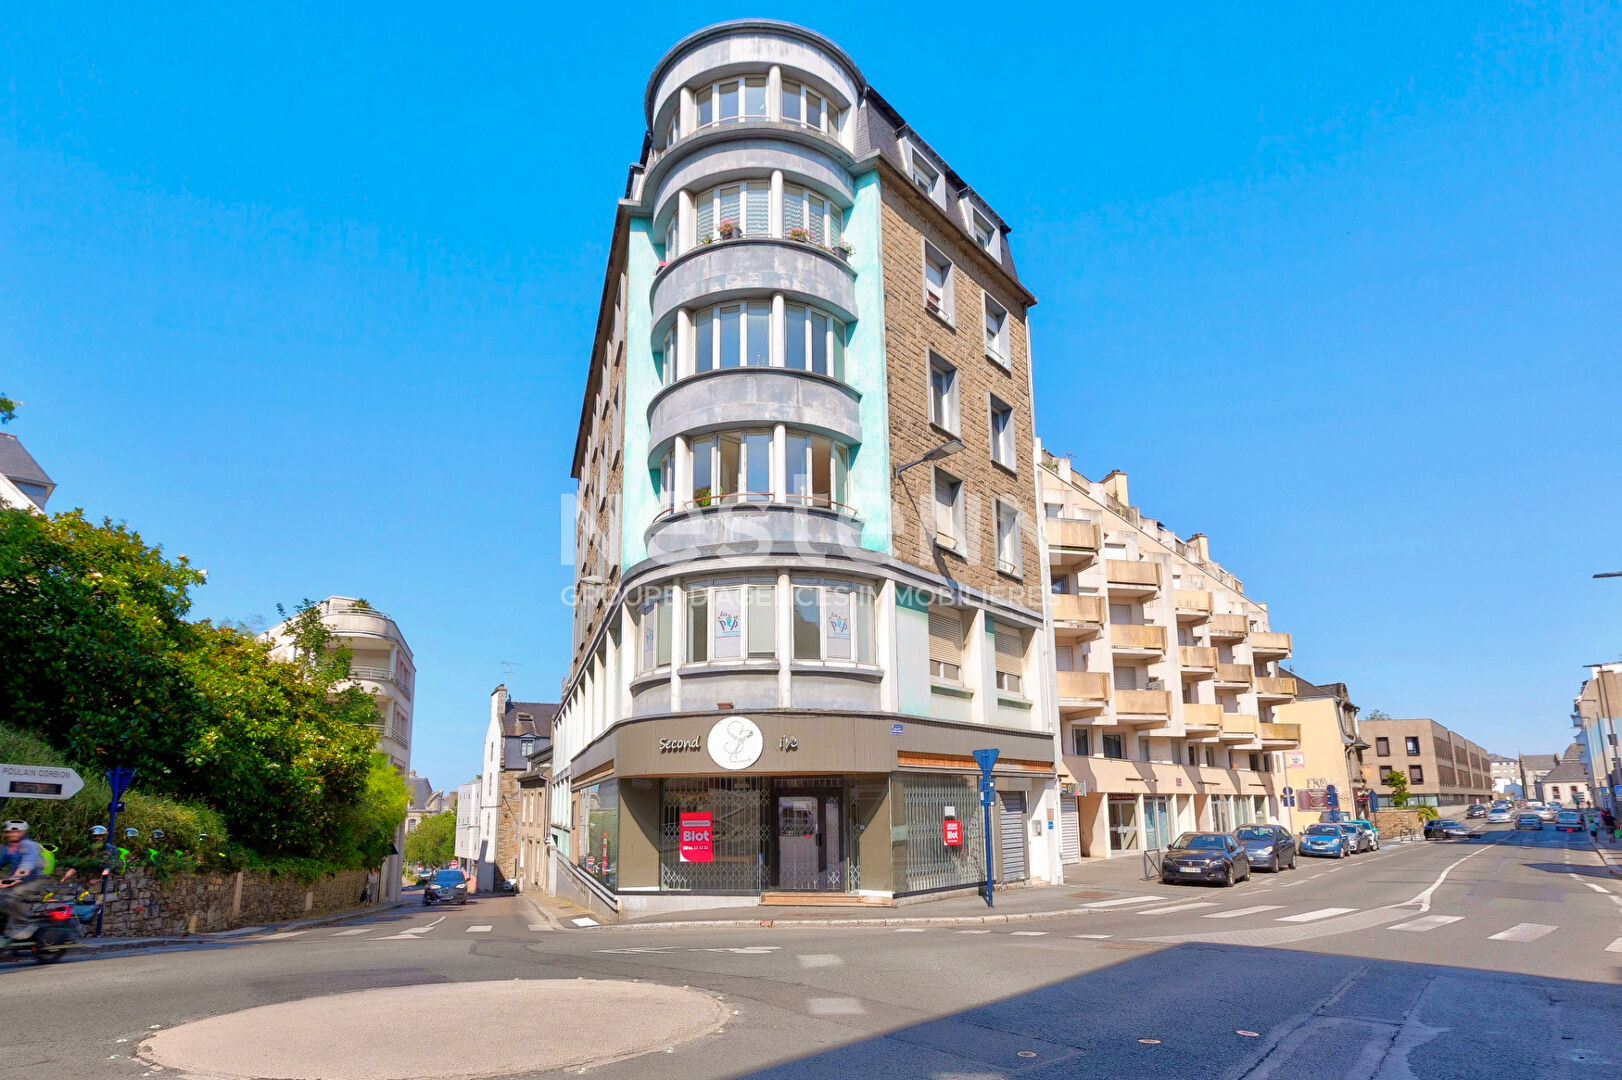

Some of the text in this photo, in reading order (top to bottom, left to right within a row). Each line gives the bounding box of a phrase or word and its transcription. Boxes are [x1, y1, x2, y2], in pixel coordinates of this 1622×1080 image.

[659, 734, 700, 751] Second
[2, 767, 71, 779] POULAIN CORBION
[683, 830, 710, 842] Blot
